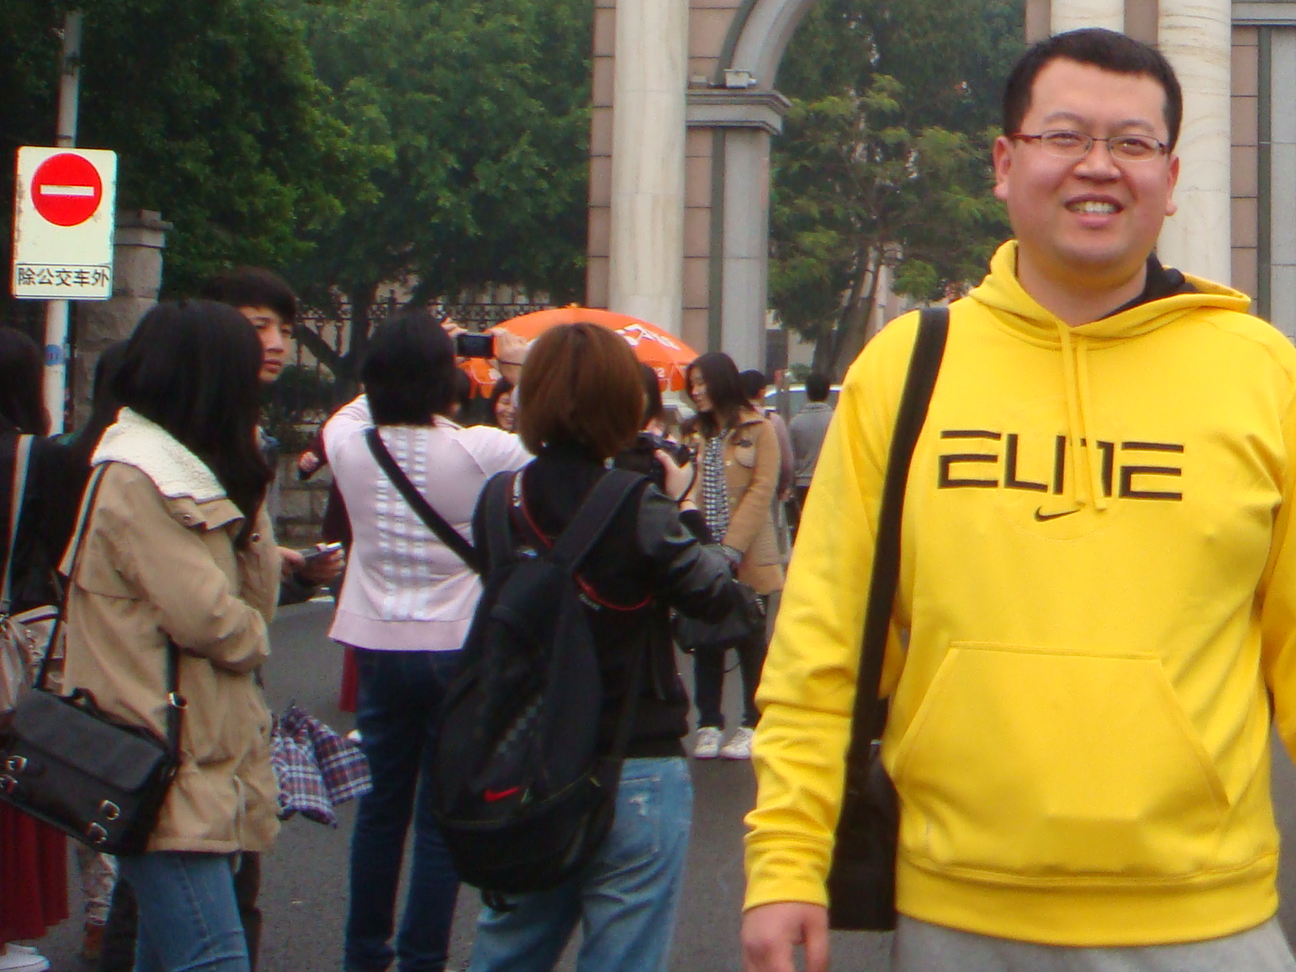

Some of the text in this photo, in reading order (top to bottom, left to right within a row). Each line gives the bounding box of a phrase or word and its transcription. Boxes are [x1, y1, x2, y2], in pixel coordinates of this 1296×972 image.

[17, 267, 110, 288] 除公交车外
